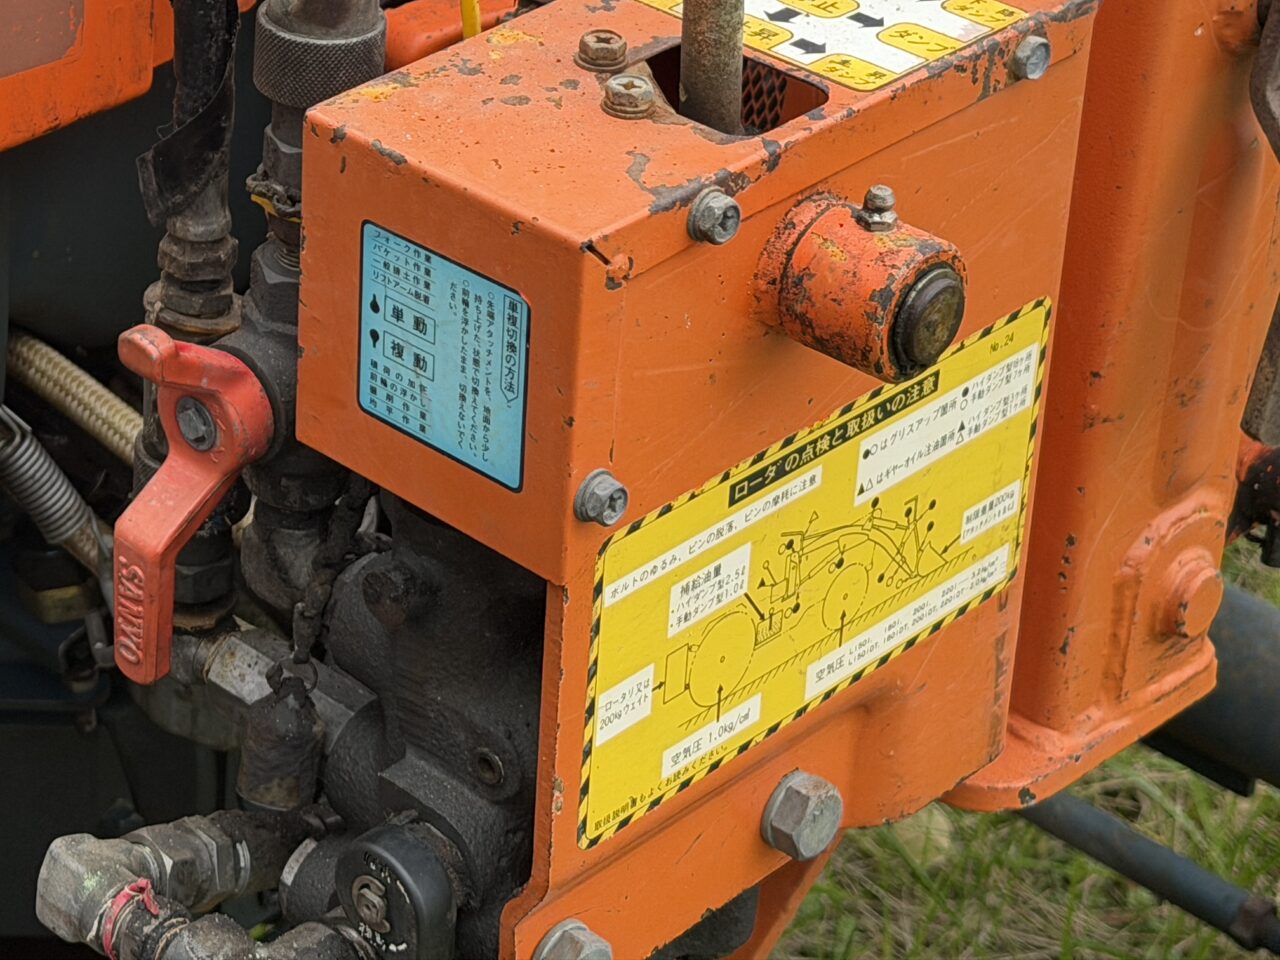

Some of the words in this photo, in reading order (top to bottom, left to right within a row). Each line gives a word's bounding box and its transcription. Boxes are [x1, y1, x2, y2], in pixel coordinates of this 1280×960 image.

[888, 29, 956, 52] ダンプ
[391, 305, 428, 336] 単動
[391, 340, 428, 373] 複動
[504, 300, 518, 395] 単複切換の方法
[735, 375, 936, 498] ローダの点検と取扱いの注意
[815, 654, 846, 683] 空気圧
[670, 737, 703, 768] 空気圧
